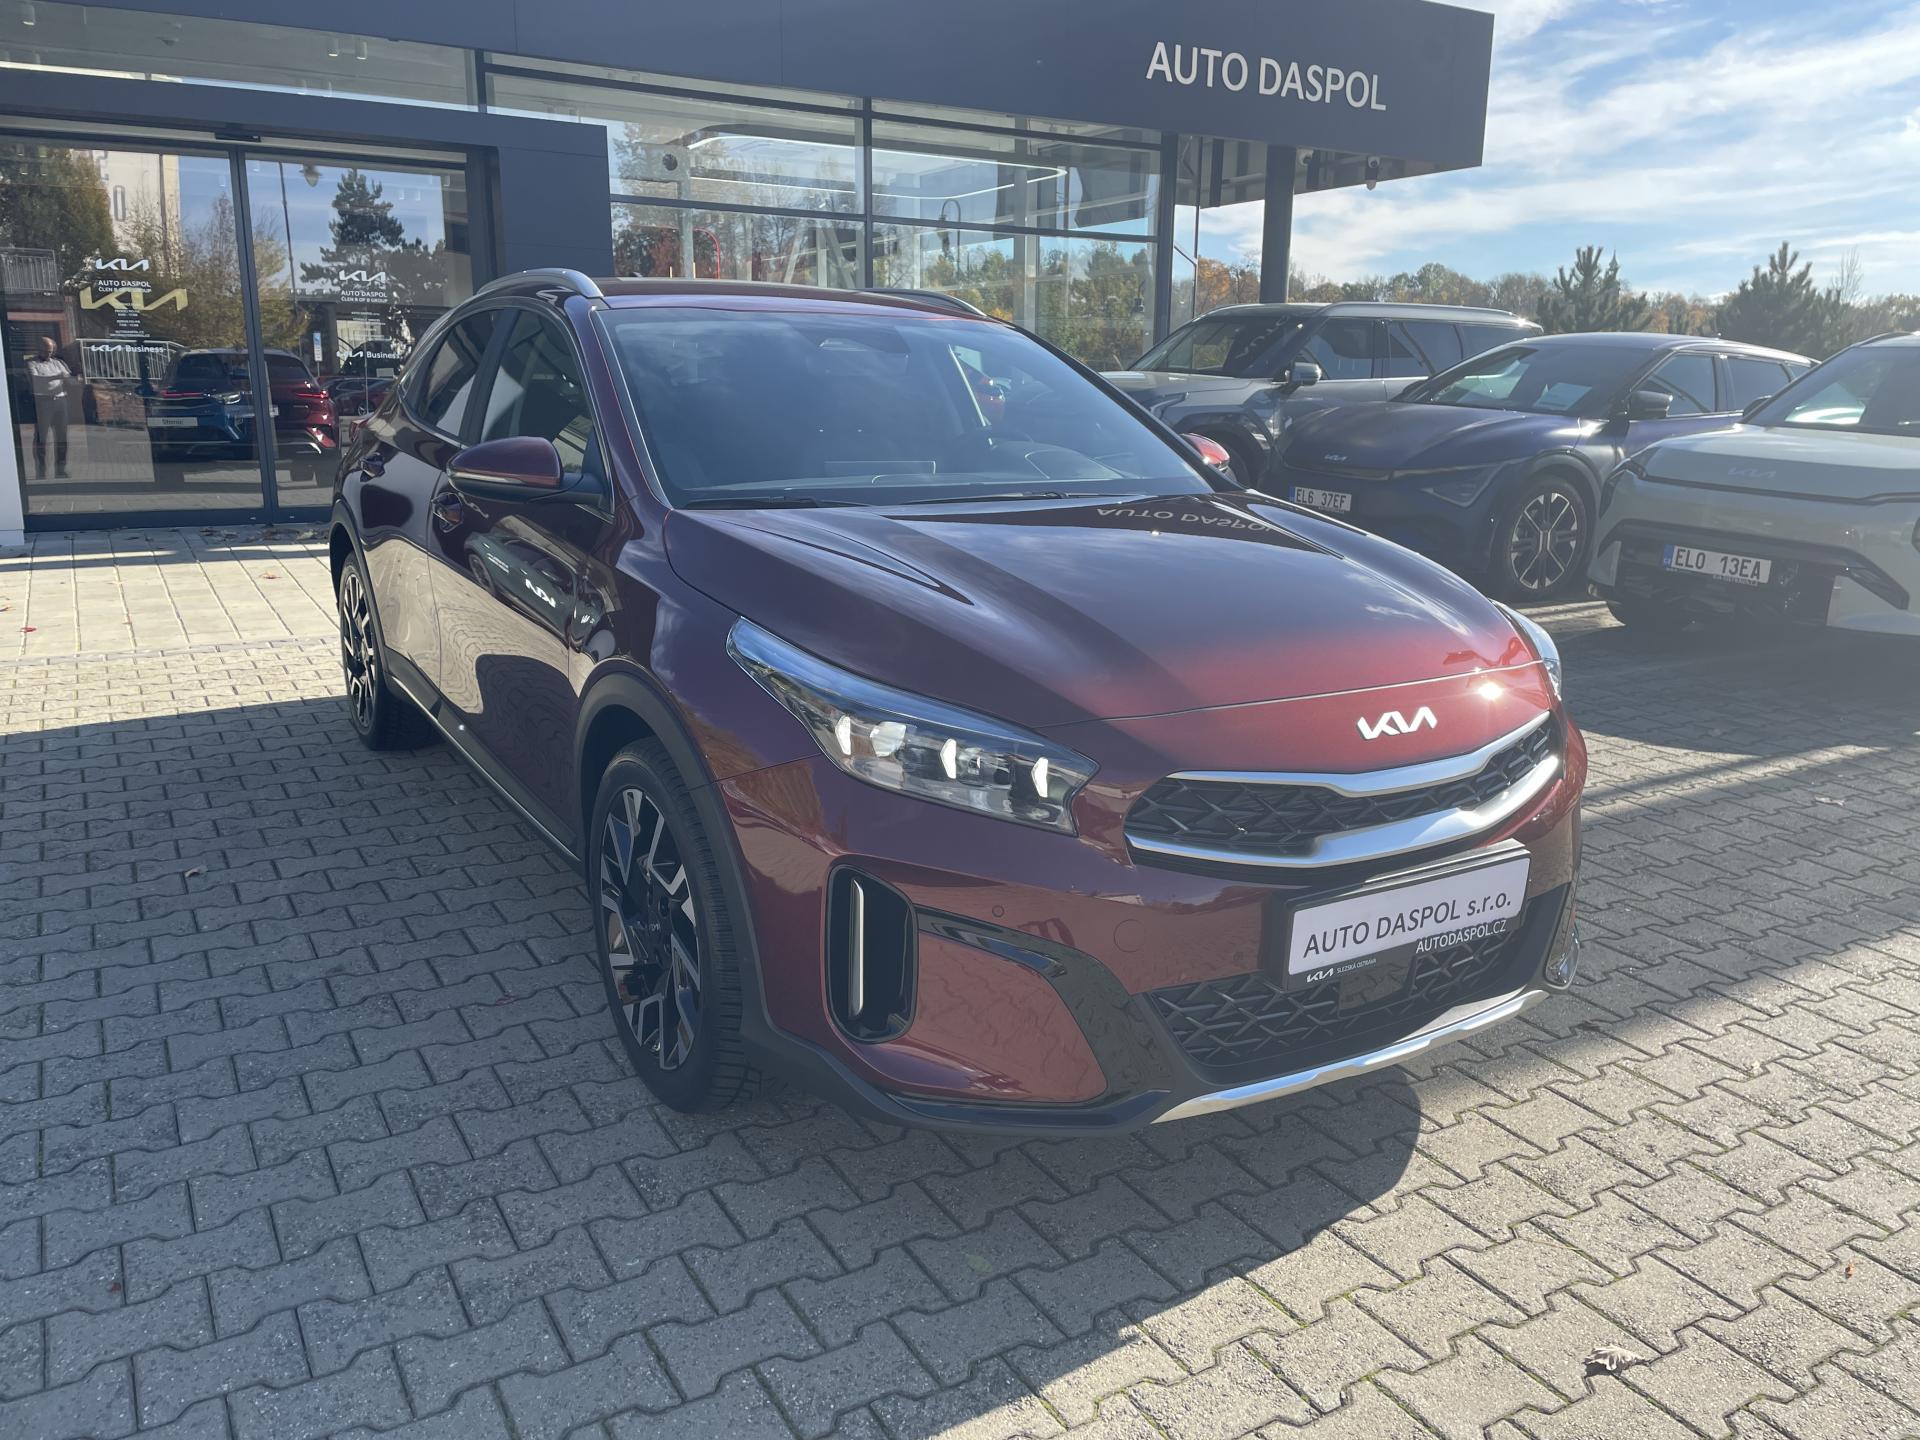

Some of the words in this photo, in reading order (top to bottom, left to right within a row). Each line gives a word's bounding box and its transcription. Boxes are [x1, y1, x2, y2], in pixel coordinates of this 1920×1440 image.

[1145, 41, 1248, 92] AUTO
[1258, 56, 1387, 111] DASPOL
[95, 257, 150, 271] KIA
[338, 269, 387, 284] KIA
[98, 279, 120, 287] AUTO
[121, 280, 151, 288] DASPOL
[79, 285, 188, 311] KIA
[125, 344, 164, 353] Business
[366, 351, 400, 359] Business
[1296, 488, 1314, 504] EL6
[1321, 492, 1347, 509] 37EF
[1719, 555, 1761, 580] 13EA
[1356, 705, 1438, 740] KIA
[1303, 921, 1370, 959] AUTO
[1375, 899, 1461, 939] DASPOL
[1466, 892, 1511, 916] s.r.o.
[1415, 919, 1507, 954] AUTODASPOL.CZ
[1306, 967, 1334, 983] KIA
[1336, 962, 1356, 974] SLEZSKÁ
[1356, 958, 1377, 969] OSTRAVA
